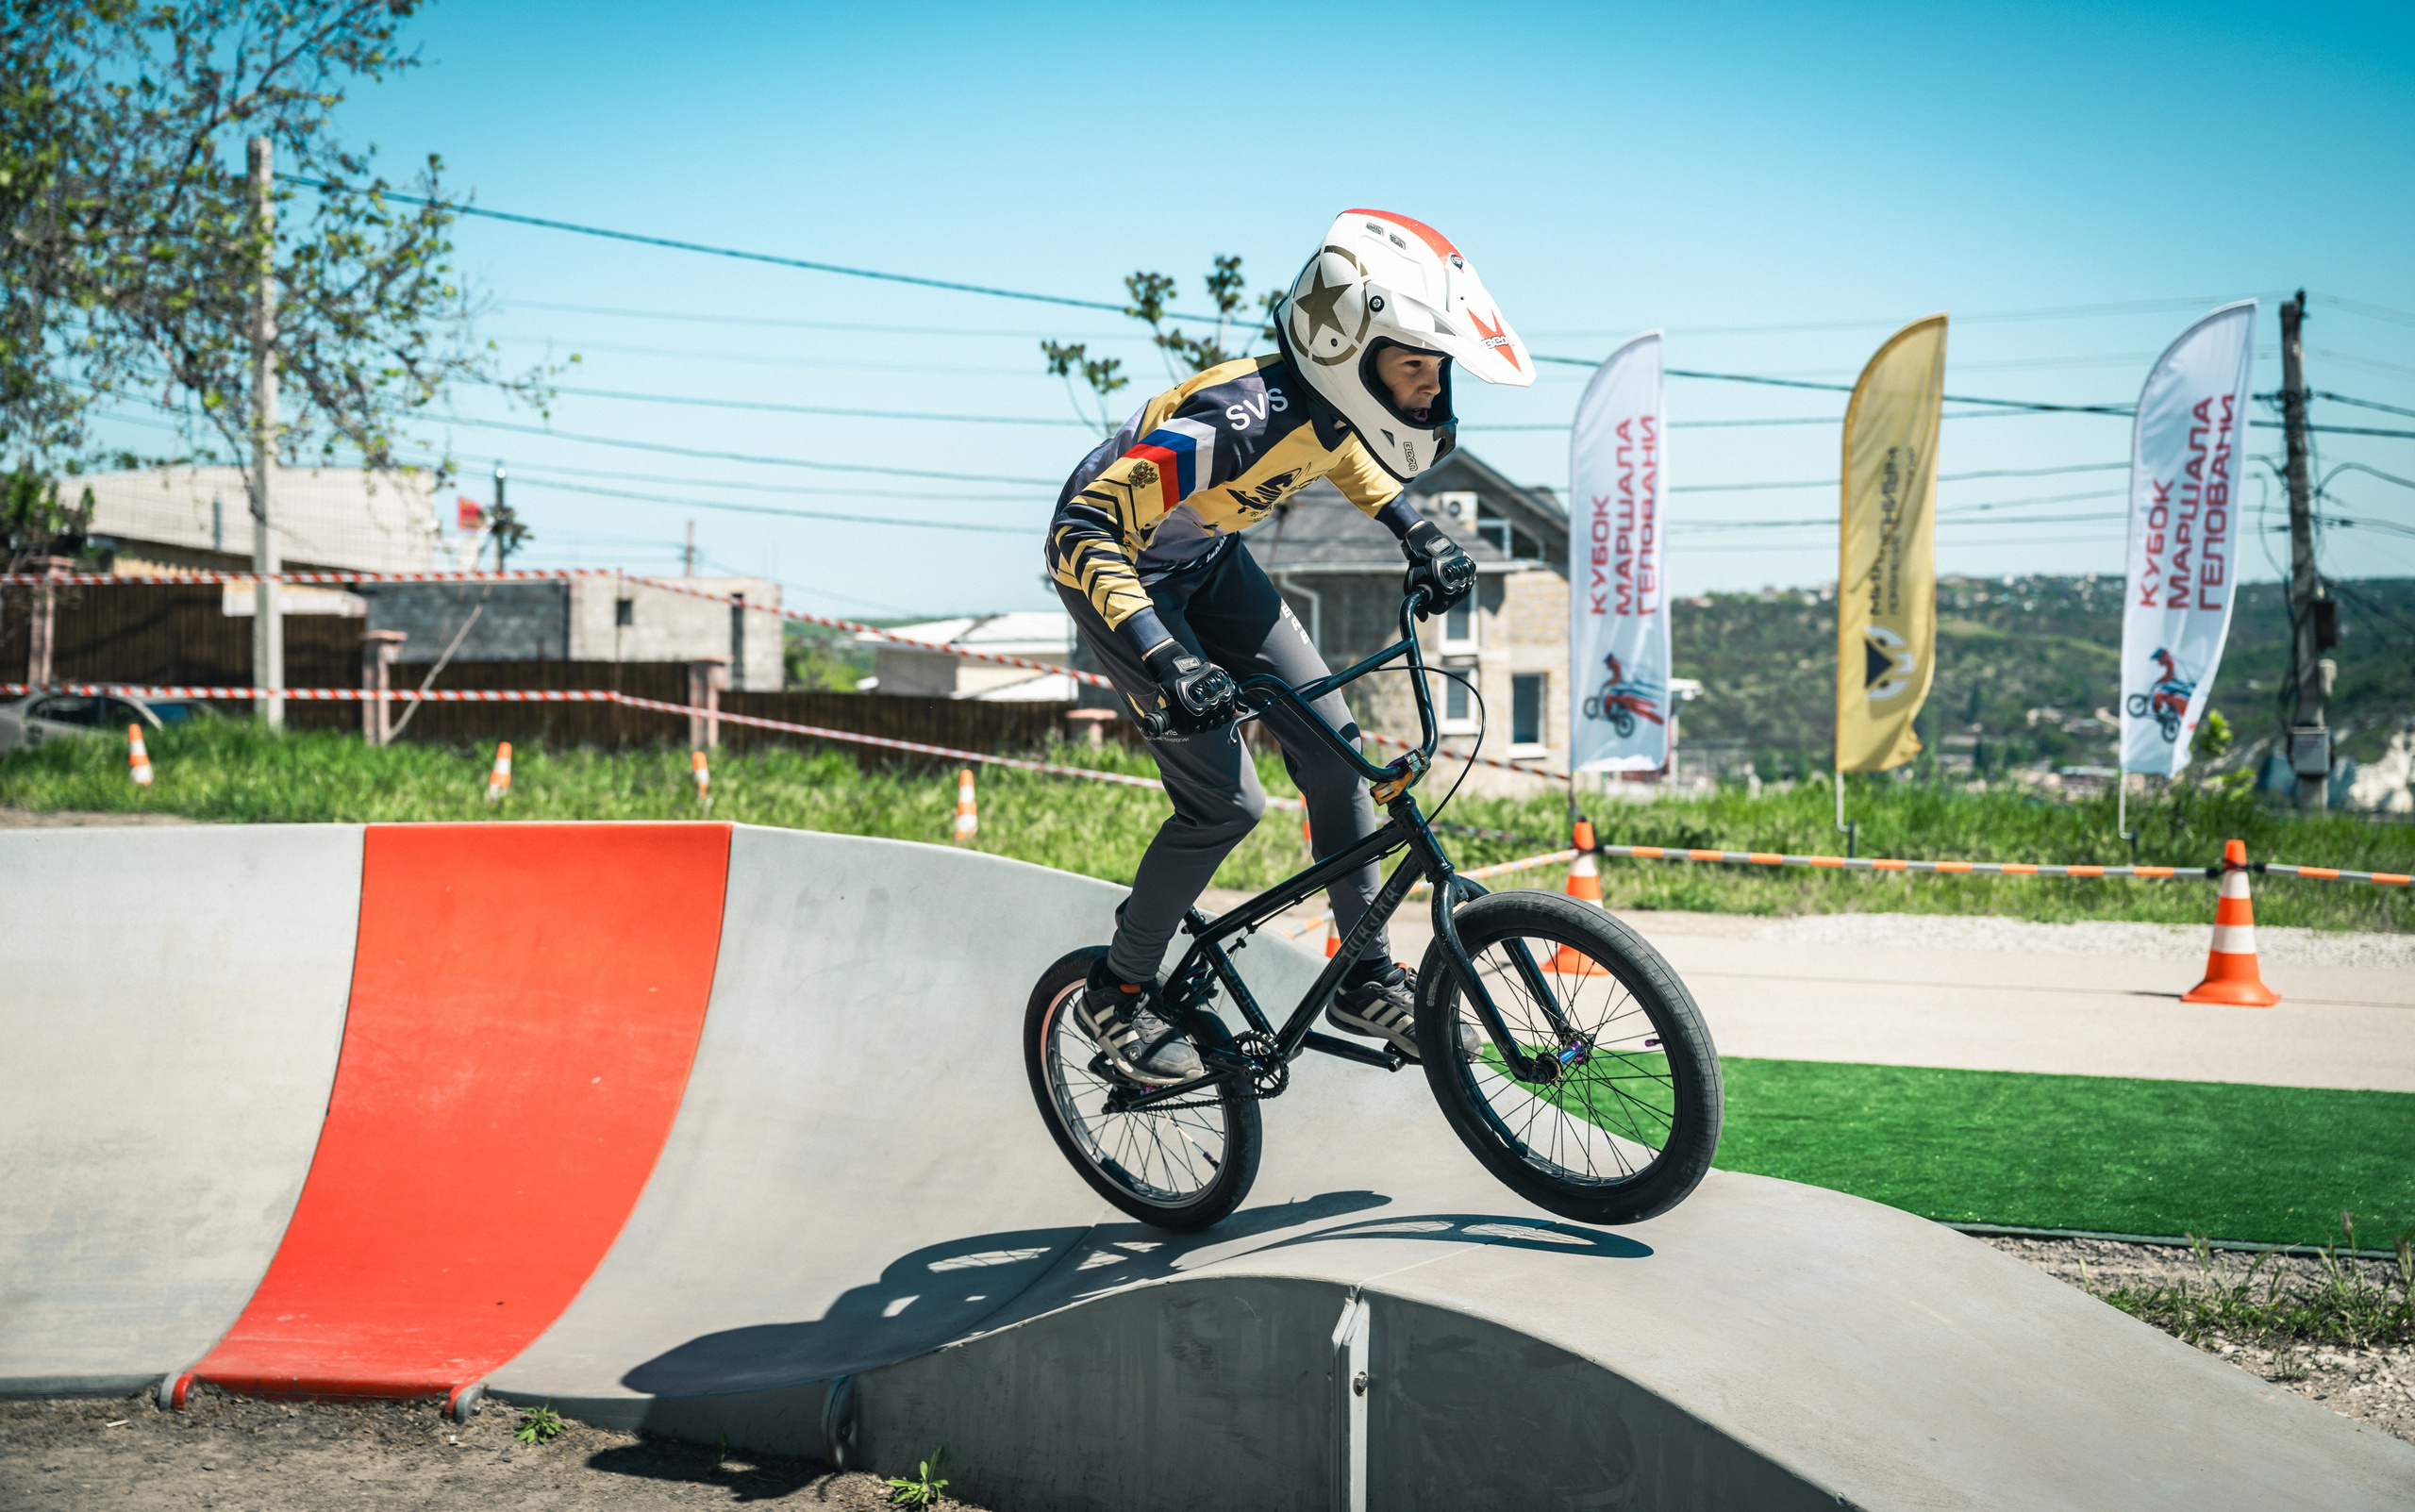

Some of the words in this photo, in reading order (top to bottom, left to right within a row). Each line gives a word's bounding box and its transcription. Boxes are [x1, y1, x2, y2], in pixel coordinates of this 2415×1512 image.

[1225, 388, 1289, 431] SVS
[2167, 397, 2213, 609] МАРШАЛА
[2199, 394, 2235, 610] ГЕЛОВАНИ
[1591, 496, 1609, 615] КУБОК
[1616, 418, 1635, 616] МАРШАЛА
[1638, 415, 1657, 616] ГЕЛОВАНИ
[2140, 479, 2174, 607] КУБОК
